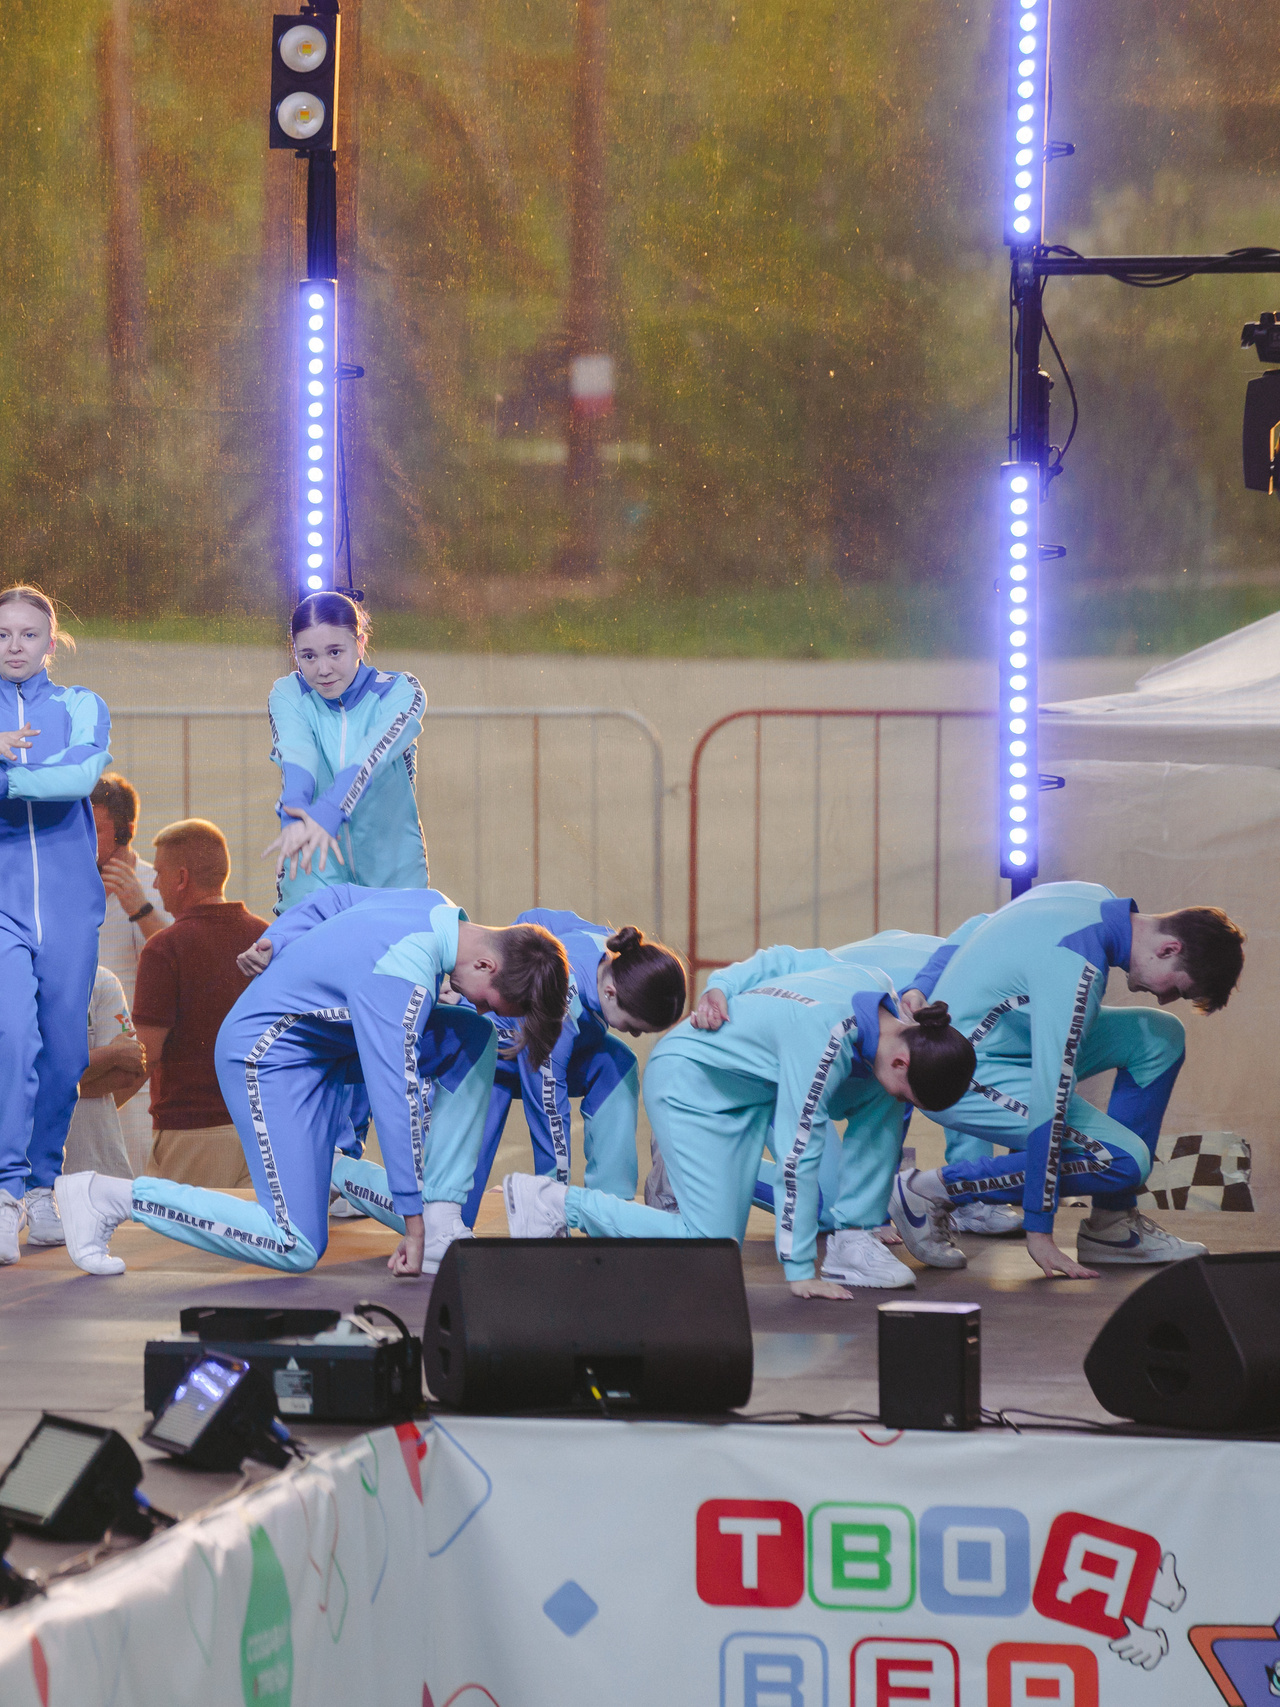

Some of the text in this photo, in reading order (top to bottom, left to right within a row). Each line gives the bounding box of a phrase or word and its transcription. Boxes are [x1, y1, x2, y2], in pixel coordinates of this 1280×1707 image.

[388, 711, 409, 739] PELSIN
[403, 990, 424, 1072] APELS ALLET
[968, 1012, 1000, 1047] PELSIN
[1064, 965, 1095, 1066] APELSIN BALLET
[245, 1070, 263, 1123] APELSIN
[799, 1035, 841, 1131] APELSIN BALLET
[1054, 1073, 1071, 1120] BALLET
[257, 1132, 277, 1179] BALLET
[550, 1116, 567, 1158] APELSI
[1047, 1121, 1064, 1176] APELSIN
[1063, 1126, 1103, 1154] APELS
[369, 1192, 394, 1213] BALLE
[781, 1178, 797, 1232] APELSIN
[979, 1173, 1025, 1192] BALLET
[132, 1199, 167, 1218] ELSIN
[167, 1209, 215, 1232] BALLET
[223, 1226, 278, 1252] APELSIN
[715, 1513, 1140, 1623] ТВОЯ
